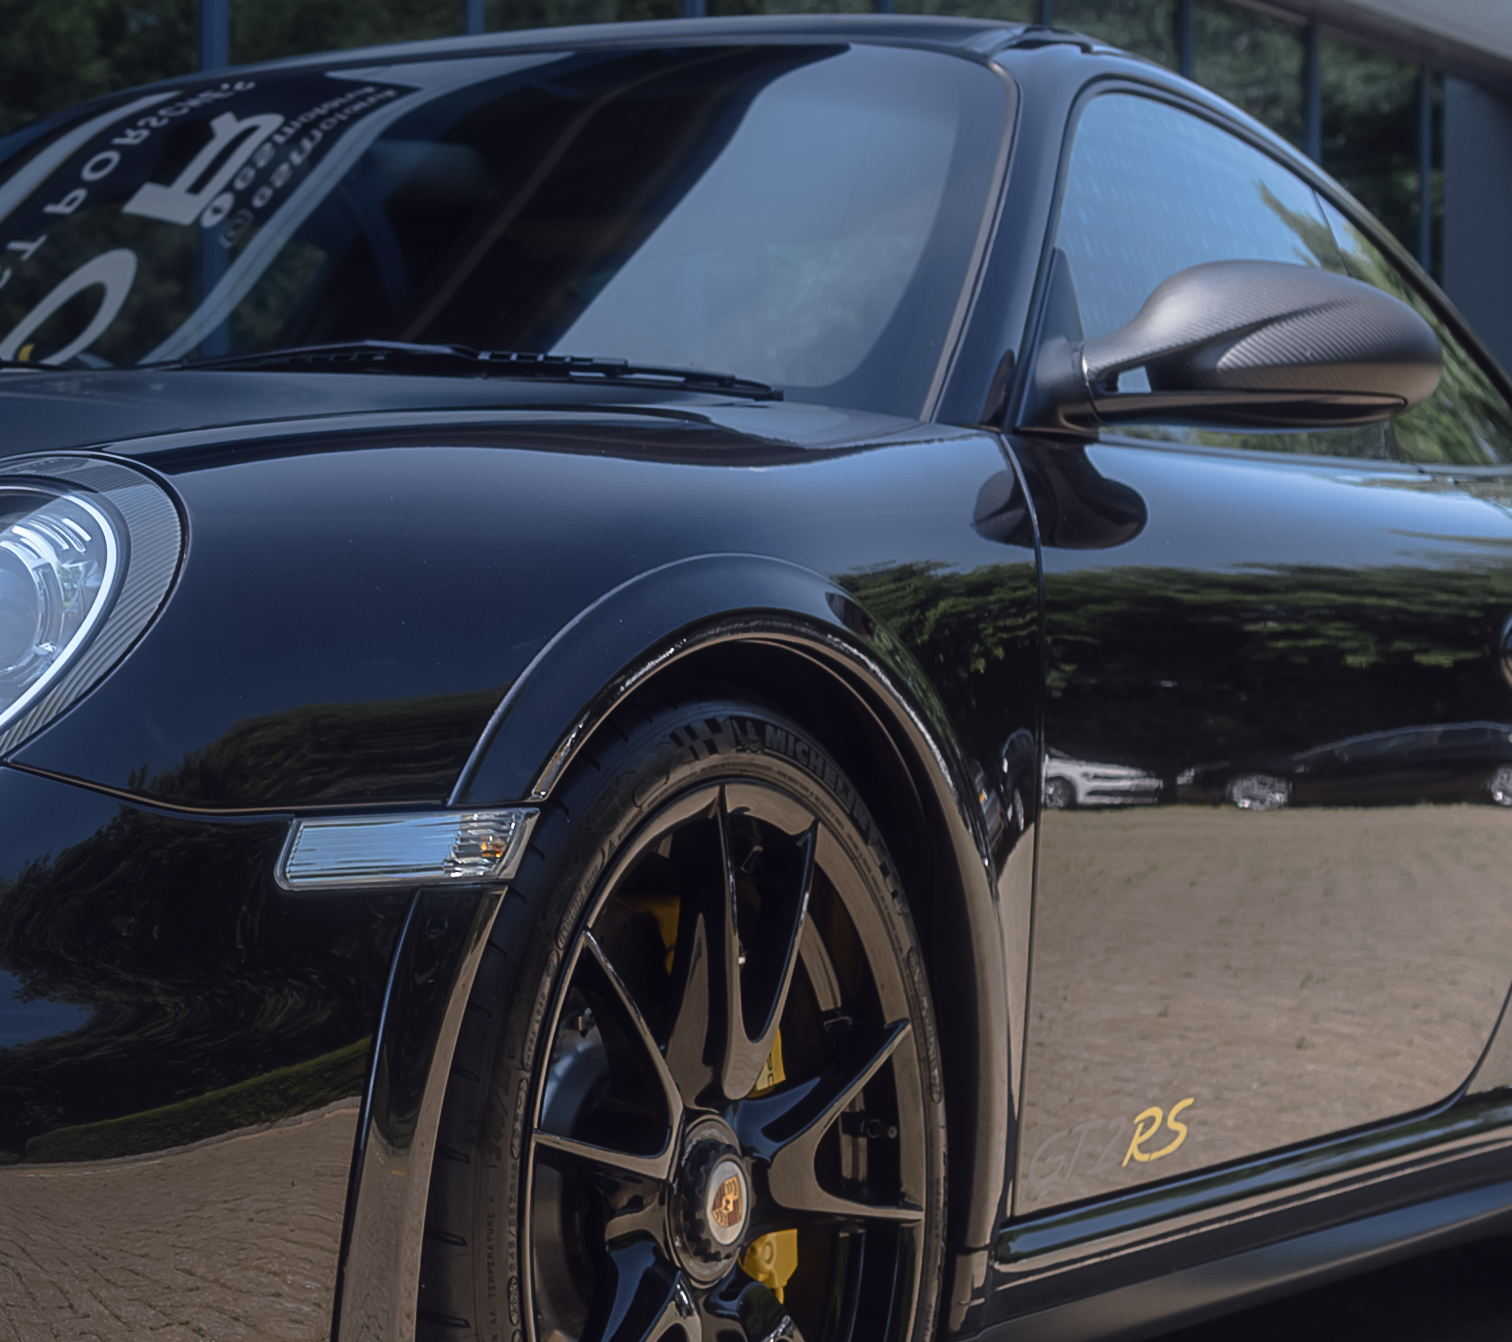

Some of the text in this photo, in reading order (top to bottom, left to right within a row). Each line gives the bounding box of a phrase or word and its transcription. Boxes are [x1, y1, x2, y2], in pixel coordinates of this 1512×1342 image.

[764, 723, 870, 831] MICHELIN
[1121, 1097, 1195, 1168] RS
[485, 1212, 496, 1300] TEMPERATURE
